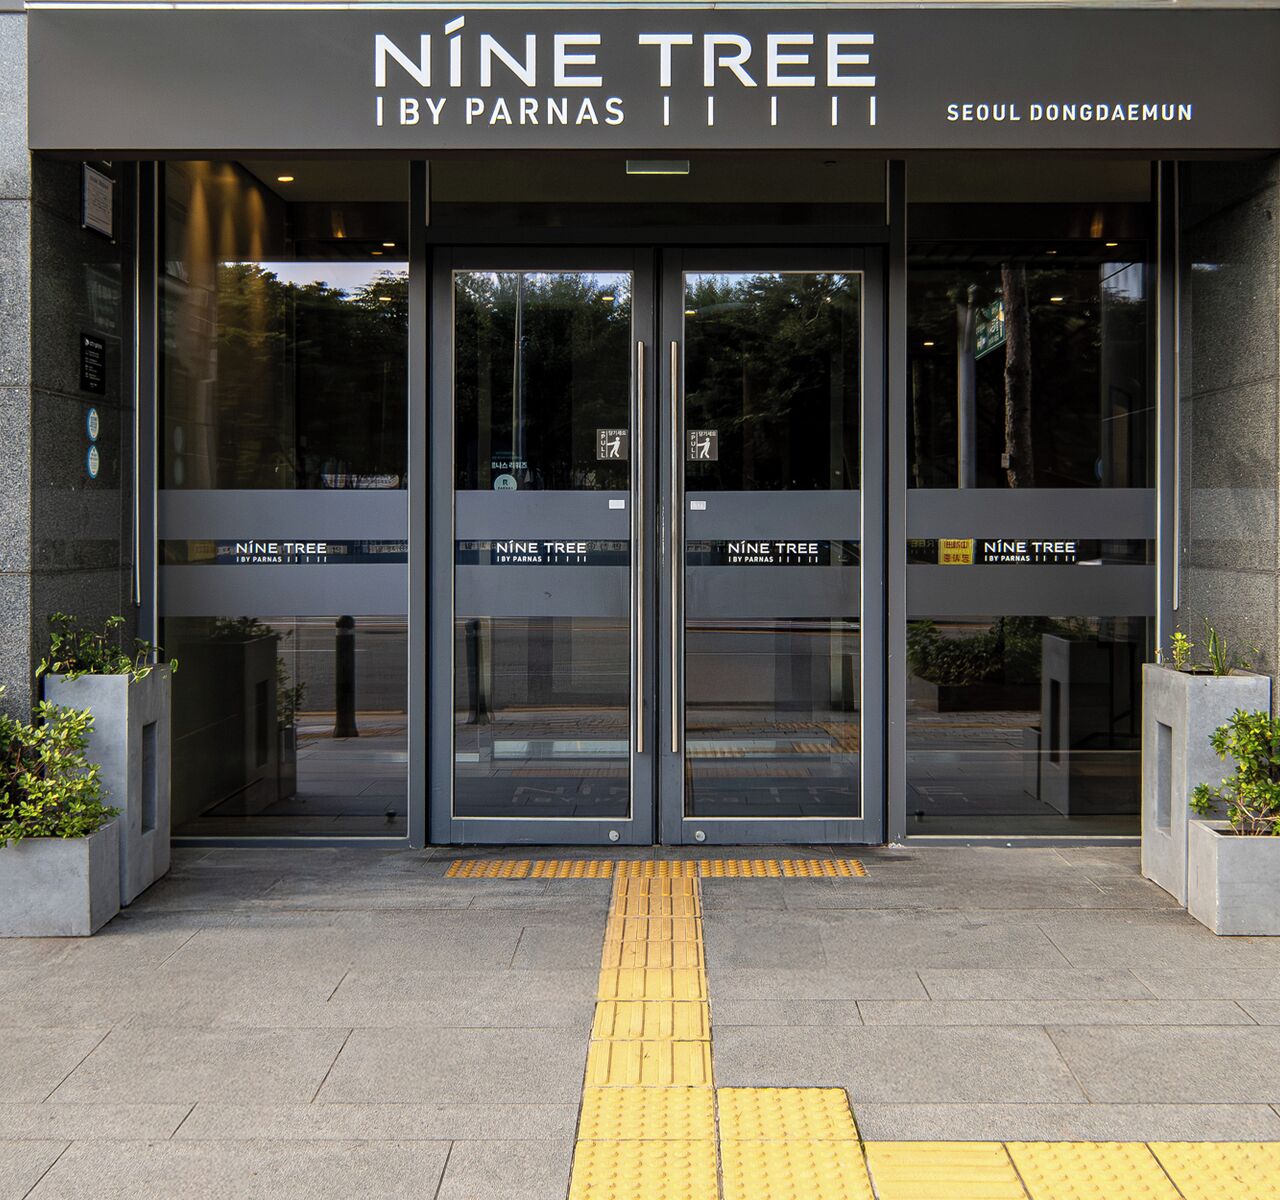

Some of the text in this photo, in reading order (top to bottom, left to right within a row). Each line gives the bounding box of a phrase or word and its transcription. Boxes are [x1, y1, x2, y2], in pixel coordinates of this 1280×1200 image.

[639, 34, 876, 87] TREE
[400, 97, 625, 126] BY PARNAS
[947, 103, 1192, 121] SEOUL DONGDAEMUN
[284, 543, 327, 554] TREE
[544, 543, 587, 554] TREE
[776, 543, 819, 554] TREE
[1032, 542, 1076, 553] TREE
